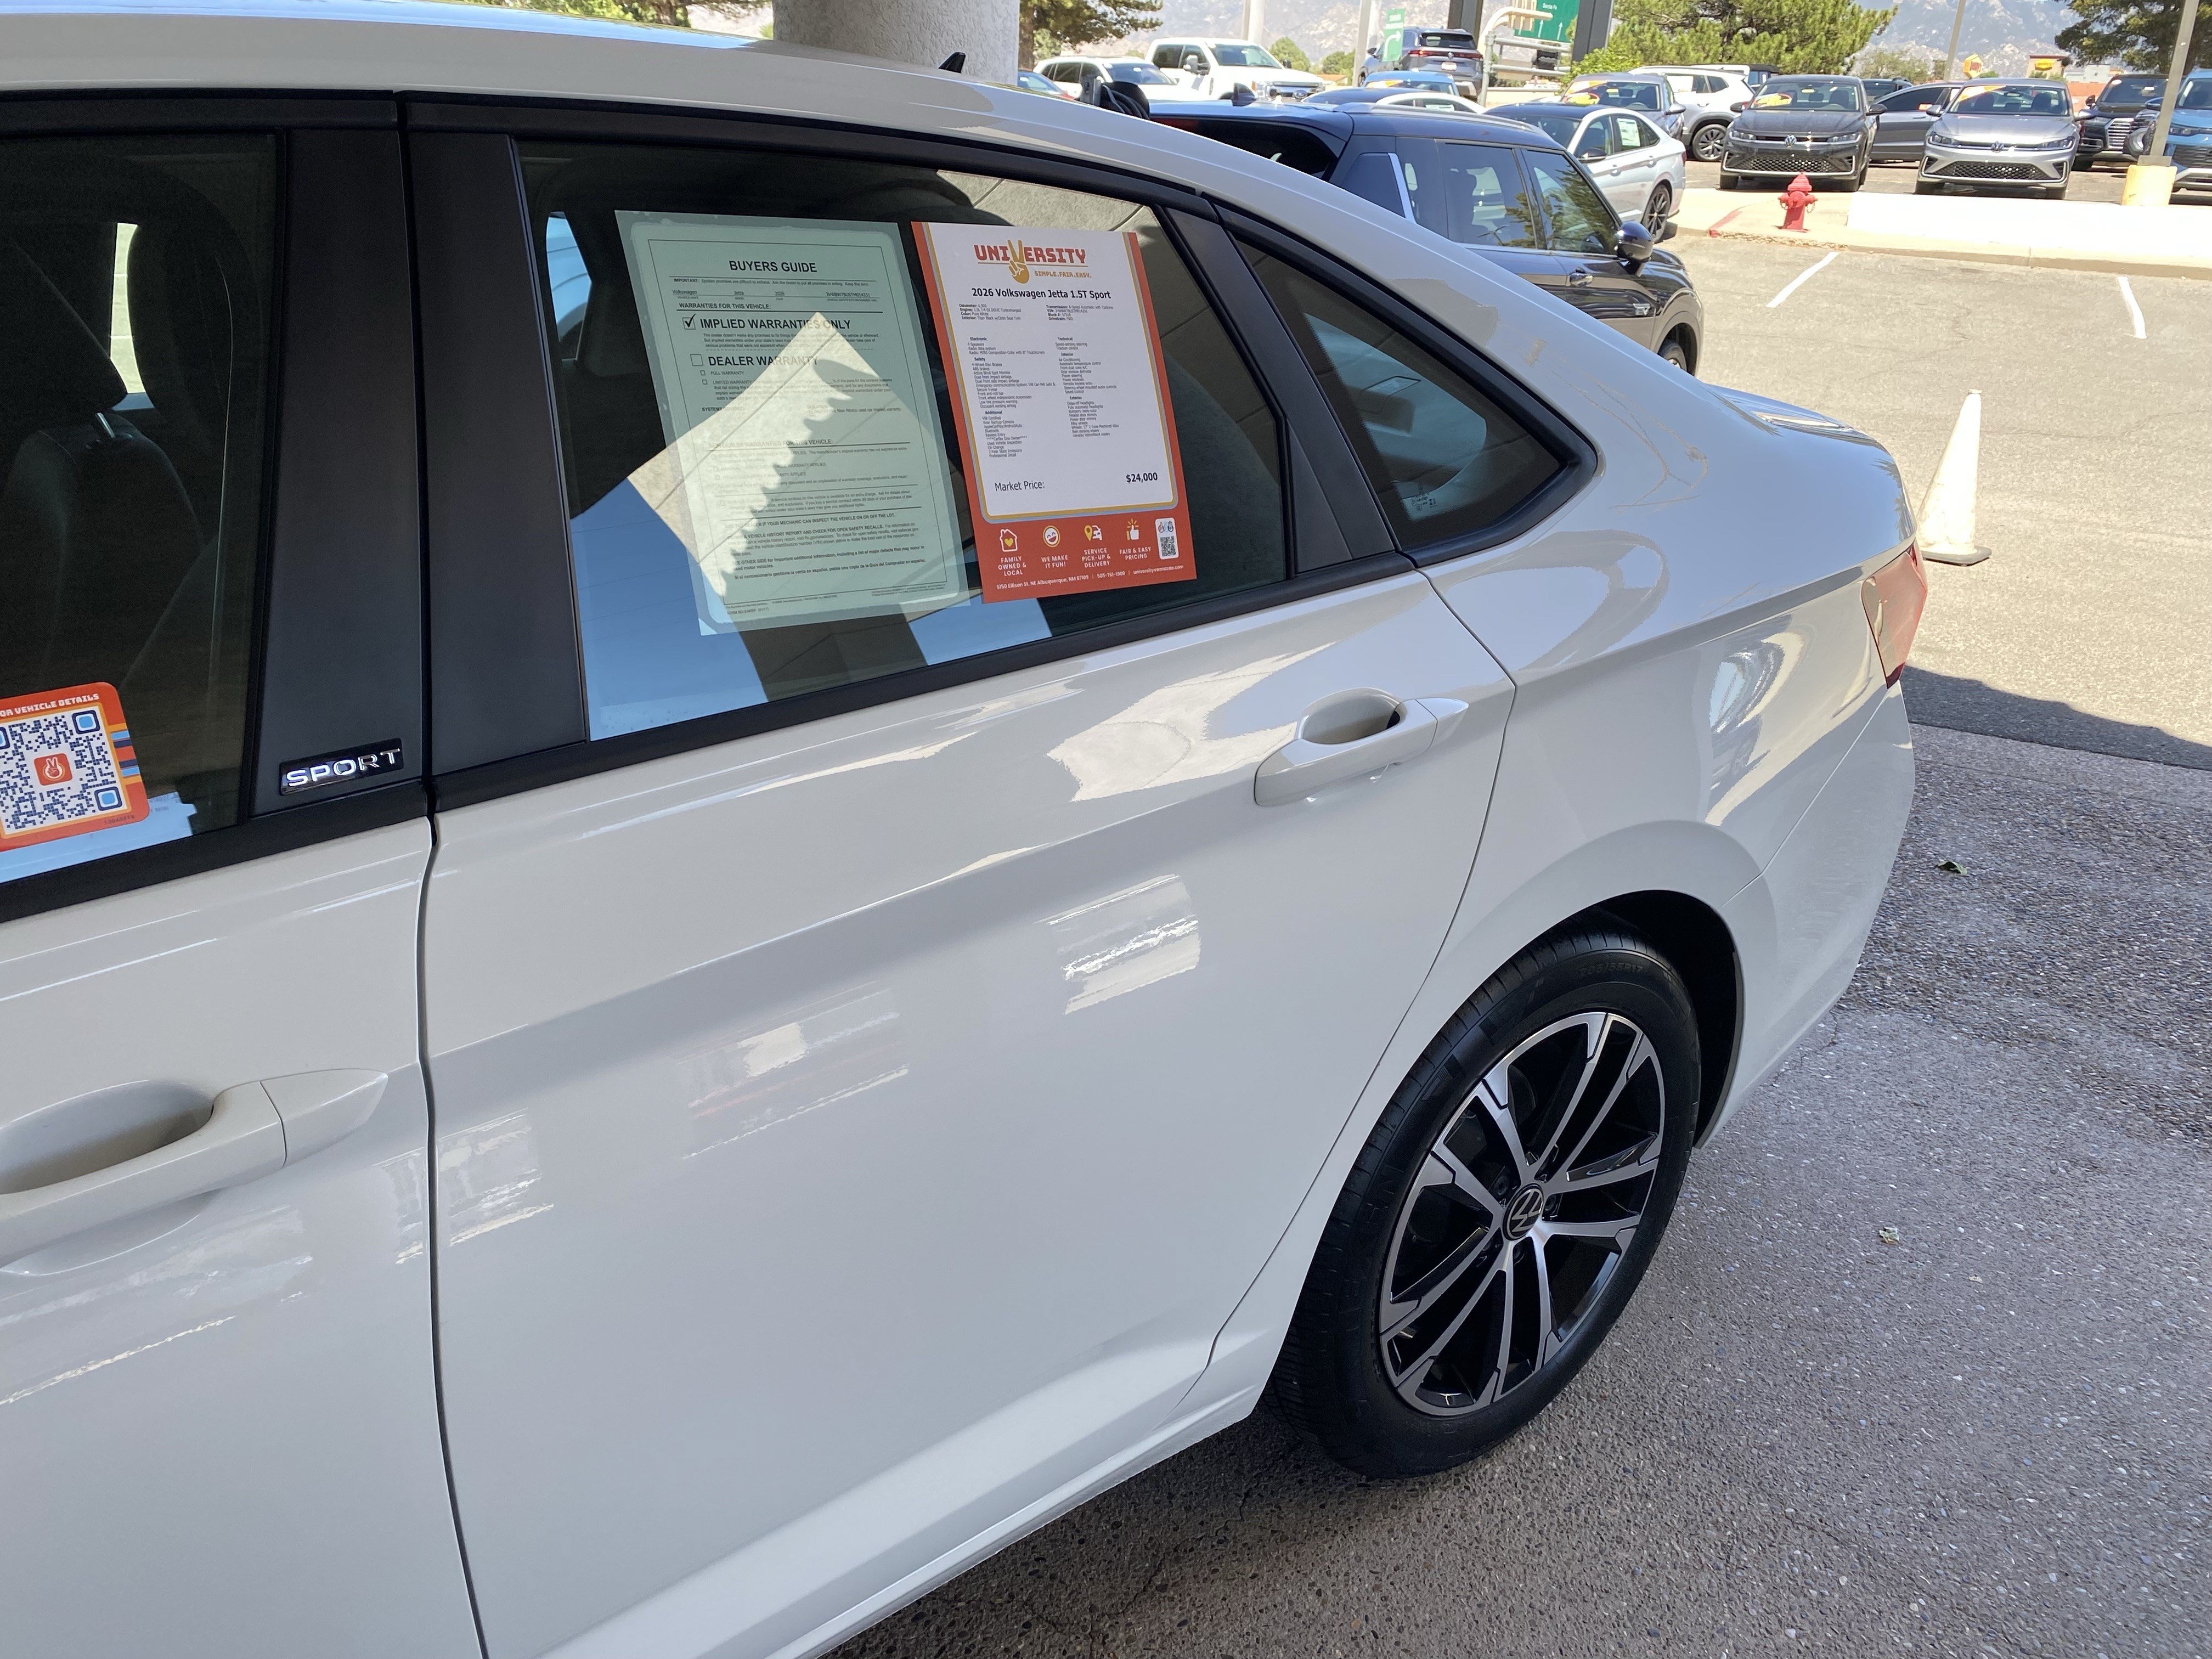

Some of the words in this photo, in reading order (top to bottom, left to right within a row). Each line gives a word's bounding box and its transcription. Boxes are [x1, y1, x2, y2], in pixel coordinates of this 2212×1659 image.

[974, 240, 1086, 263] UNIVERSITY
[729, 261, 778, 271] BUYERS
[782, 262, 817, 272] GUIDE
[972, 288, 994, 297] 2026
[995, 289, 1046, 299] Volkswagen
[1048, 290, 1068, 298] Jetta
[1070, 290, 1087, 298] 1.5T
[1090, 291, 1111, 300] Sport
[700, 319, 745, 329] IMPLIED
[748, 319, 820, 329] WARRANTIES
[823, 320, 851, 329] ONLY
[708, 357, 754, 365] DEALER
[756, 356, 817, 366] WARRANTY
[1126, 472, 1158, 484] $24,000
[995, 482, 1022, 492] Market
[1024, 481, 1045, 490] Price:
[15, 701, 57, 714] VEHICLE
[58, 693, 99, 706] DETAILS
[286, 748, 400, 787] SPORT
